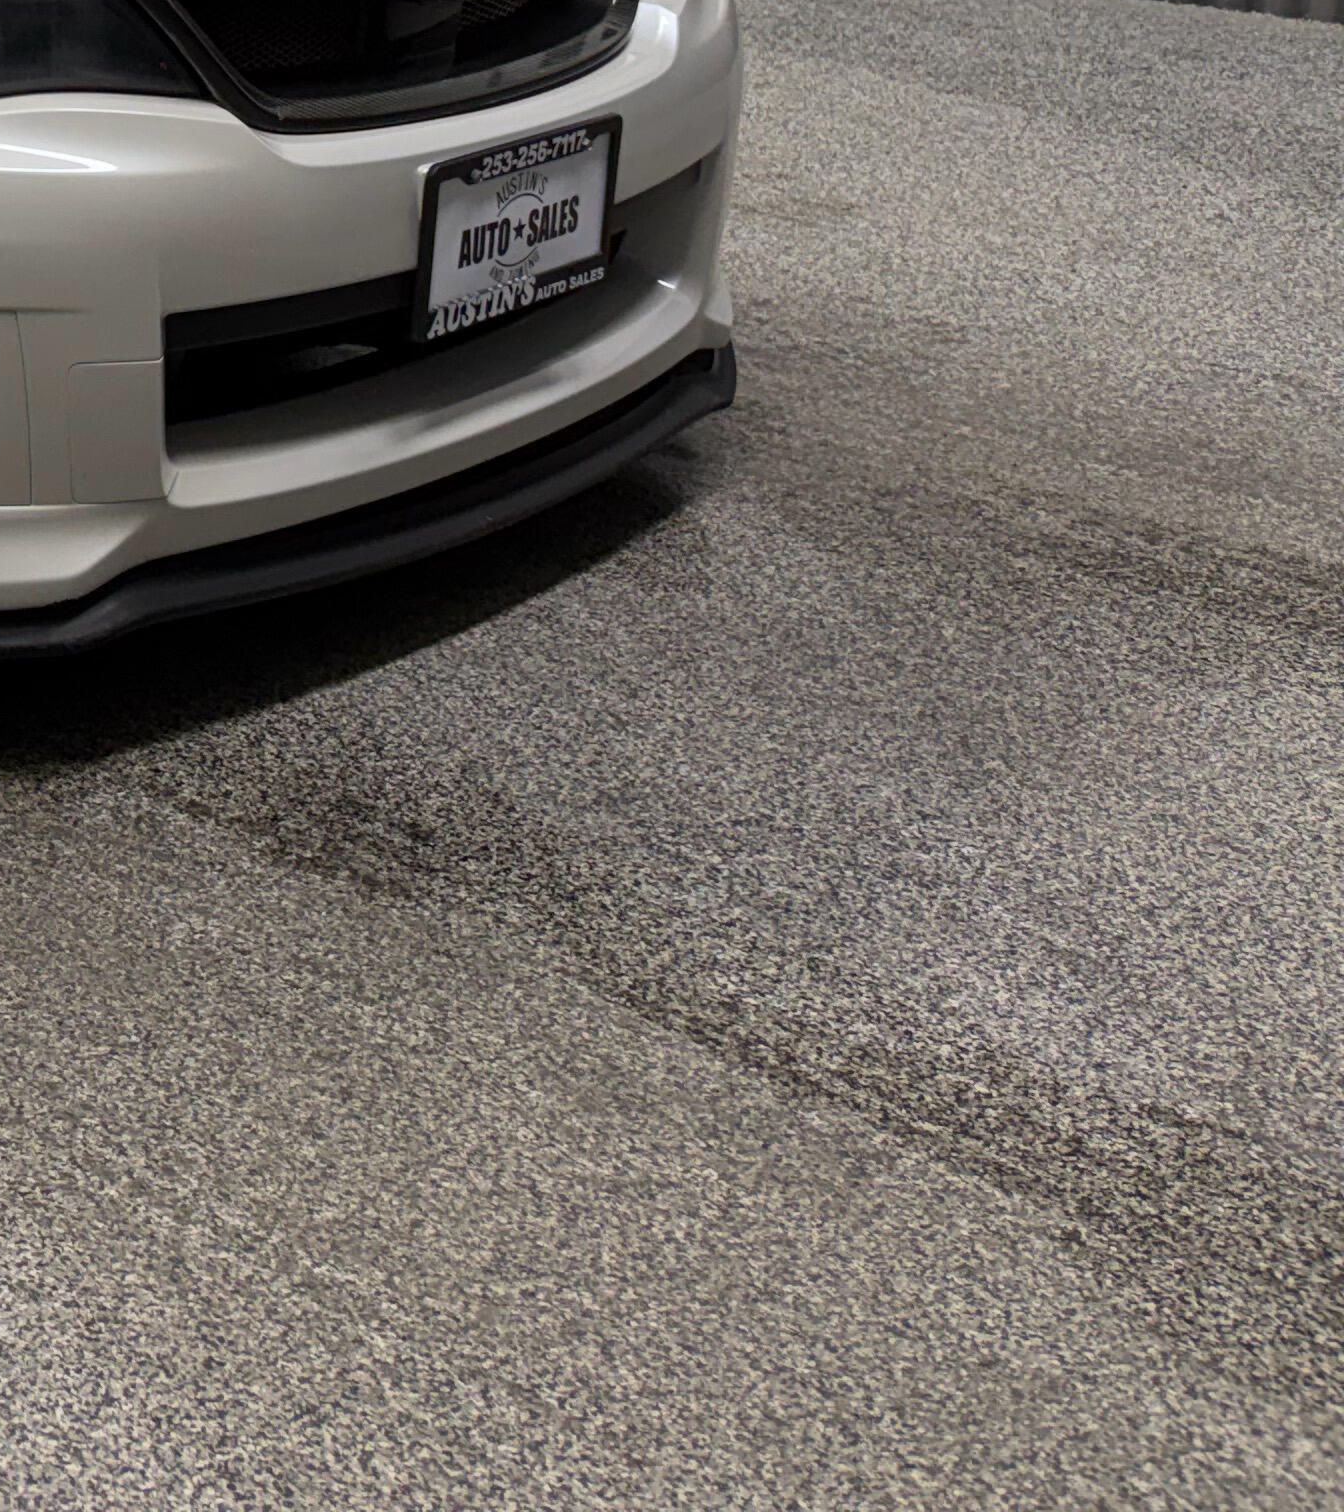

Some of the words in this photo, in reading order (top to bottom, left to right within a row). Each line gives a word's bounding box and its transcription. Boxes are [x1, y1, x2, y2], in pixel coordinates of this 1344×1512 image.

[481, 129, 587, 179] 253-256-7117
[495, 168, 550, 209] AUSTIN'S
[458, 217, 511, 269] AUTO
[525, 194, 580, 248] SALES
[427, 276, 537, 339] AUSTIN'S
[535, 279, 568, 302] AUTO
[569, 266, 605, 290] SALES
